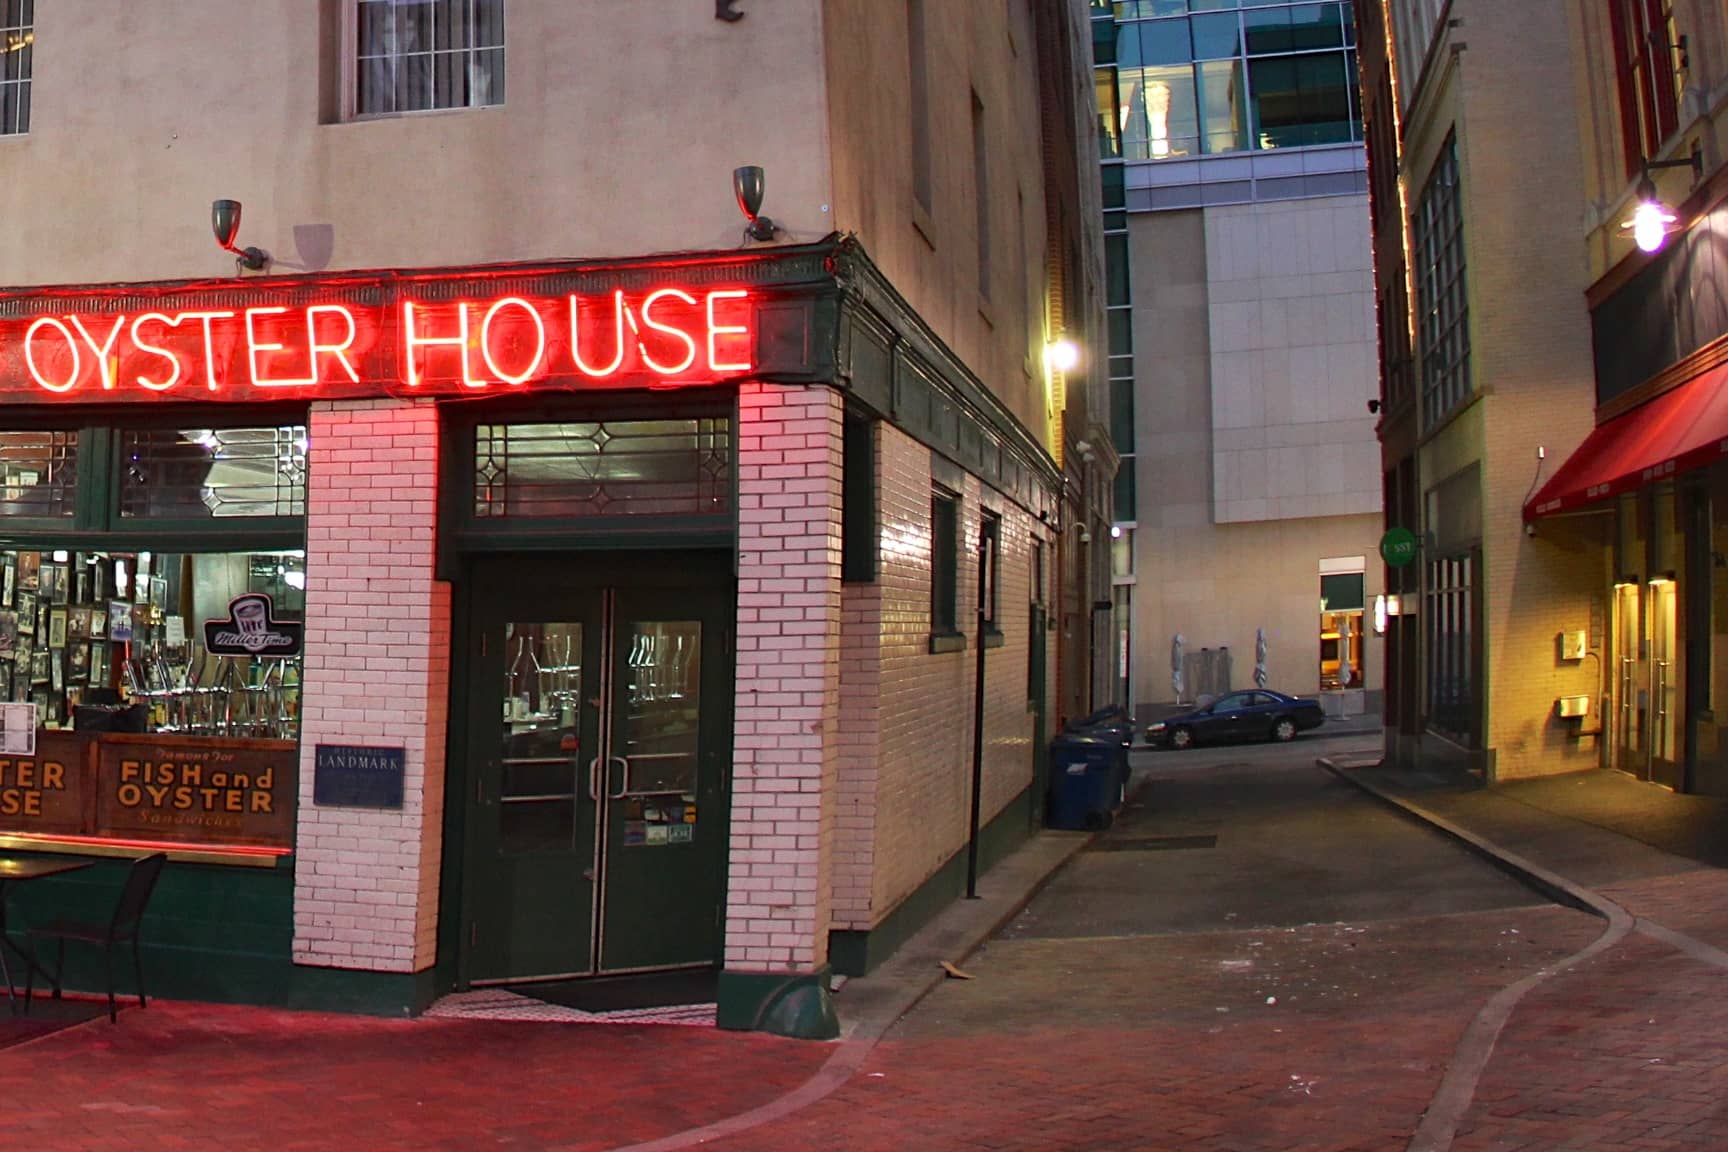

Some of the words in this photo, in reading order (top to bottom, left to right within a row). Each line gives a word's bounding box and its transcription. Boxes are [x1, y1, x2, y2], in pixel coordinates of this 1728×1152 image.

[24, 304, 360, 393] OYSTER
[403, 288, 752, 387] HOUSE
[216, 633, 258, 647] Miller
[258, 633, 291, 645] Time
[120, 760, 202, 787] FISH
[211, 767, 274, 790] and
[318, 754, 398, 769] LANDMARK
[117, 783, 274, 814] OYSTER
